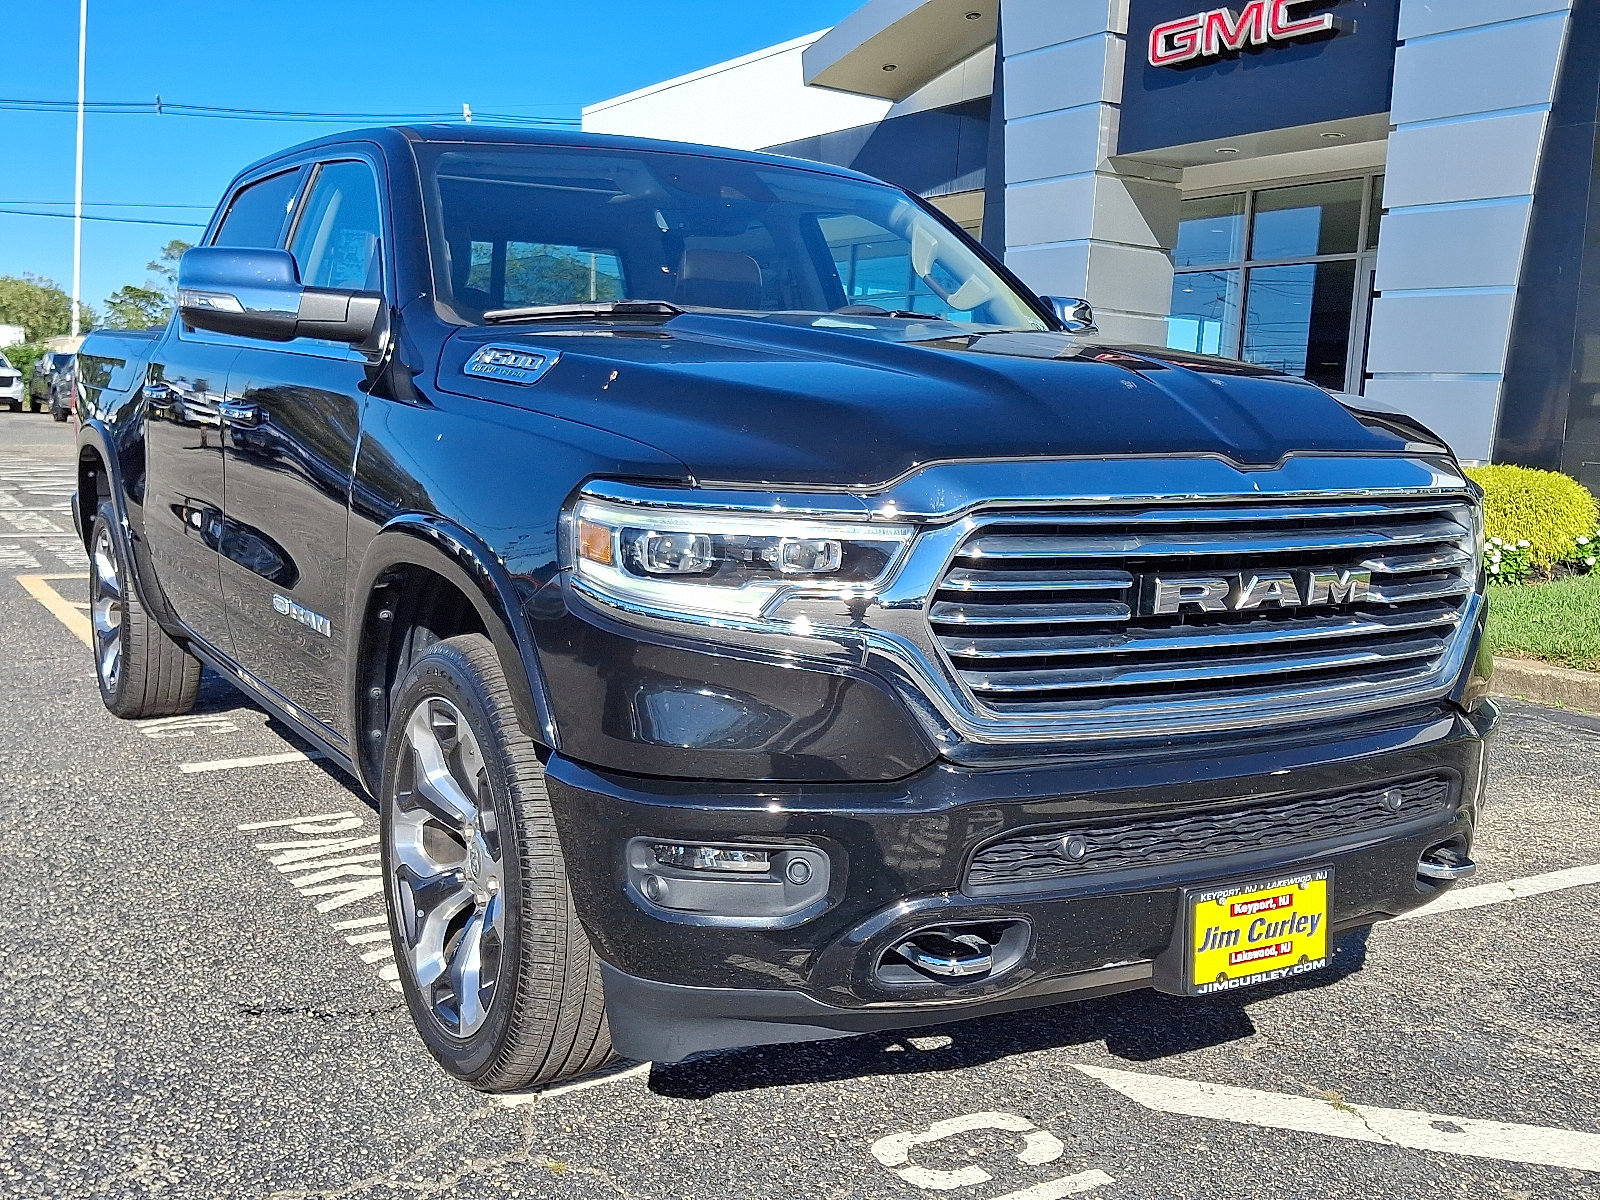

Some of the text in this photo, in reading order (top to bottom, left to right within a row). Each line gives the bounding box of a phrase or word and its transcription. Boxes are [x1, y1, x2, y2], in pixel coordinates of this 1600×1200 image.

[1148, 0, 1334, 67] GMC
[1154, 570, 1371, 615] RAM
[1245, 884, 1258, 894] NJ
[1315, 871, 1328, 881] NJ
[1233, 894, 1290, 915] Keyport, NJ
[1197, 911, 1322, 953] Jim Curley
[1231, 941, 1291, 964] Lakewood, NJ
[1197, 958, 1326, 994] JIMCURLEY.COM
